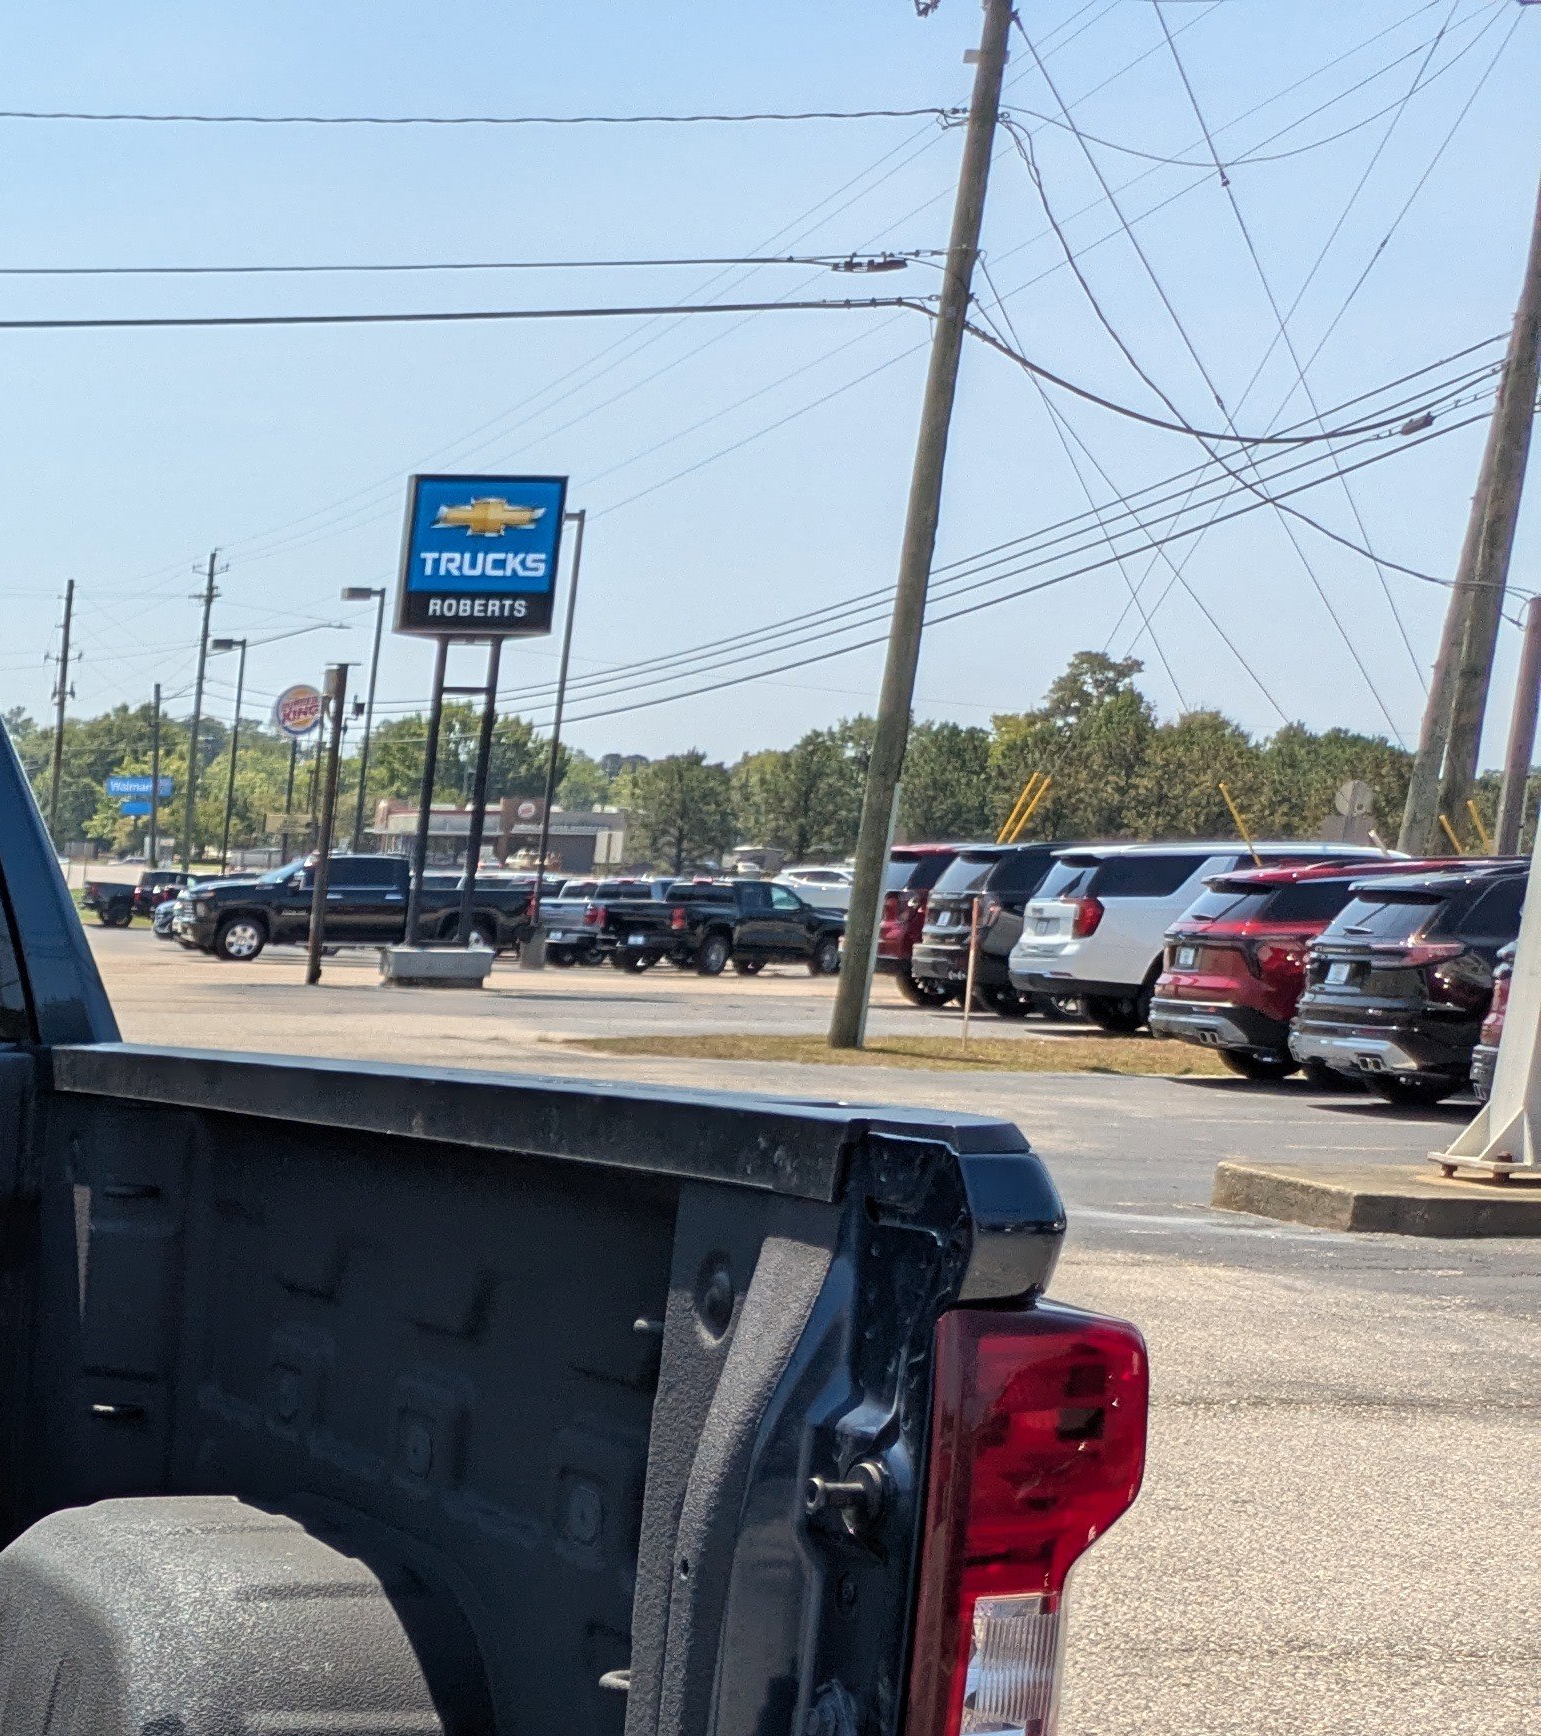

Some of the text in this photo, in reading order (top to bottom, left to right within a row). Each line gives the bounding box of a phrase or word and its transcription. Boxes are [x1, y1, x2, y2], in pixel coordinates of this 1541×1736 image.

[420, 552, 546, 577] TRUCKS
[428, 598, 527, 617] ROBERTS
[110, 781, 154, 792] Walmar
